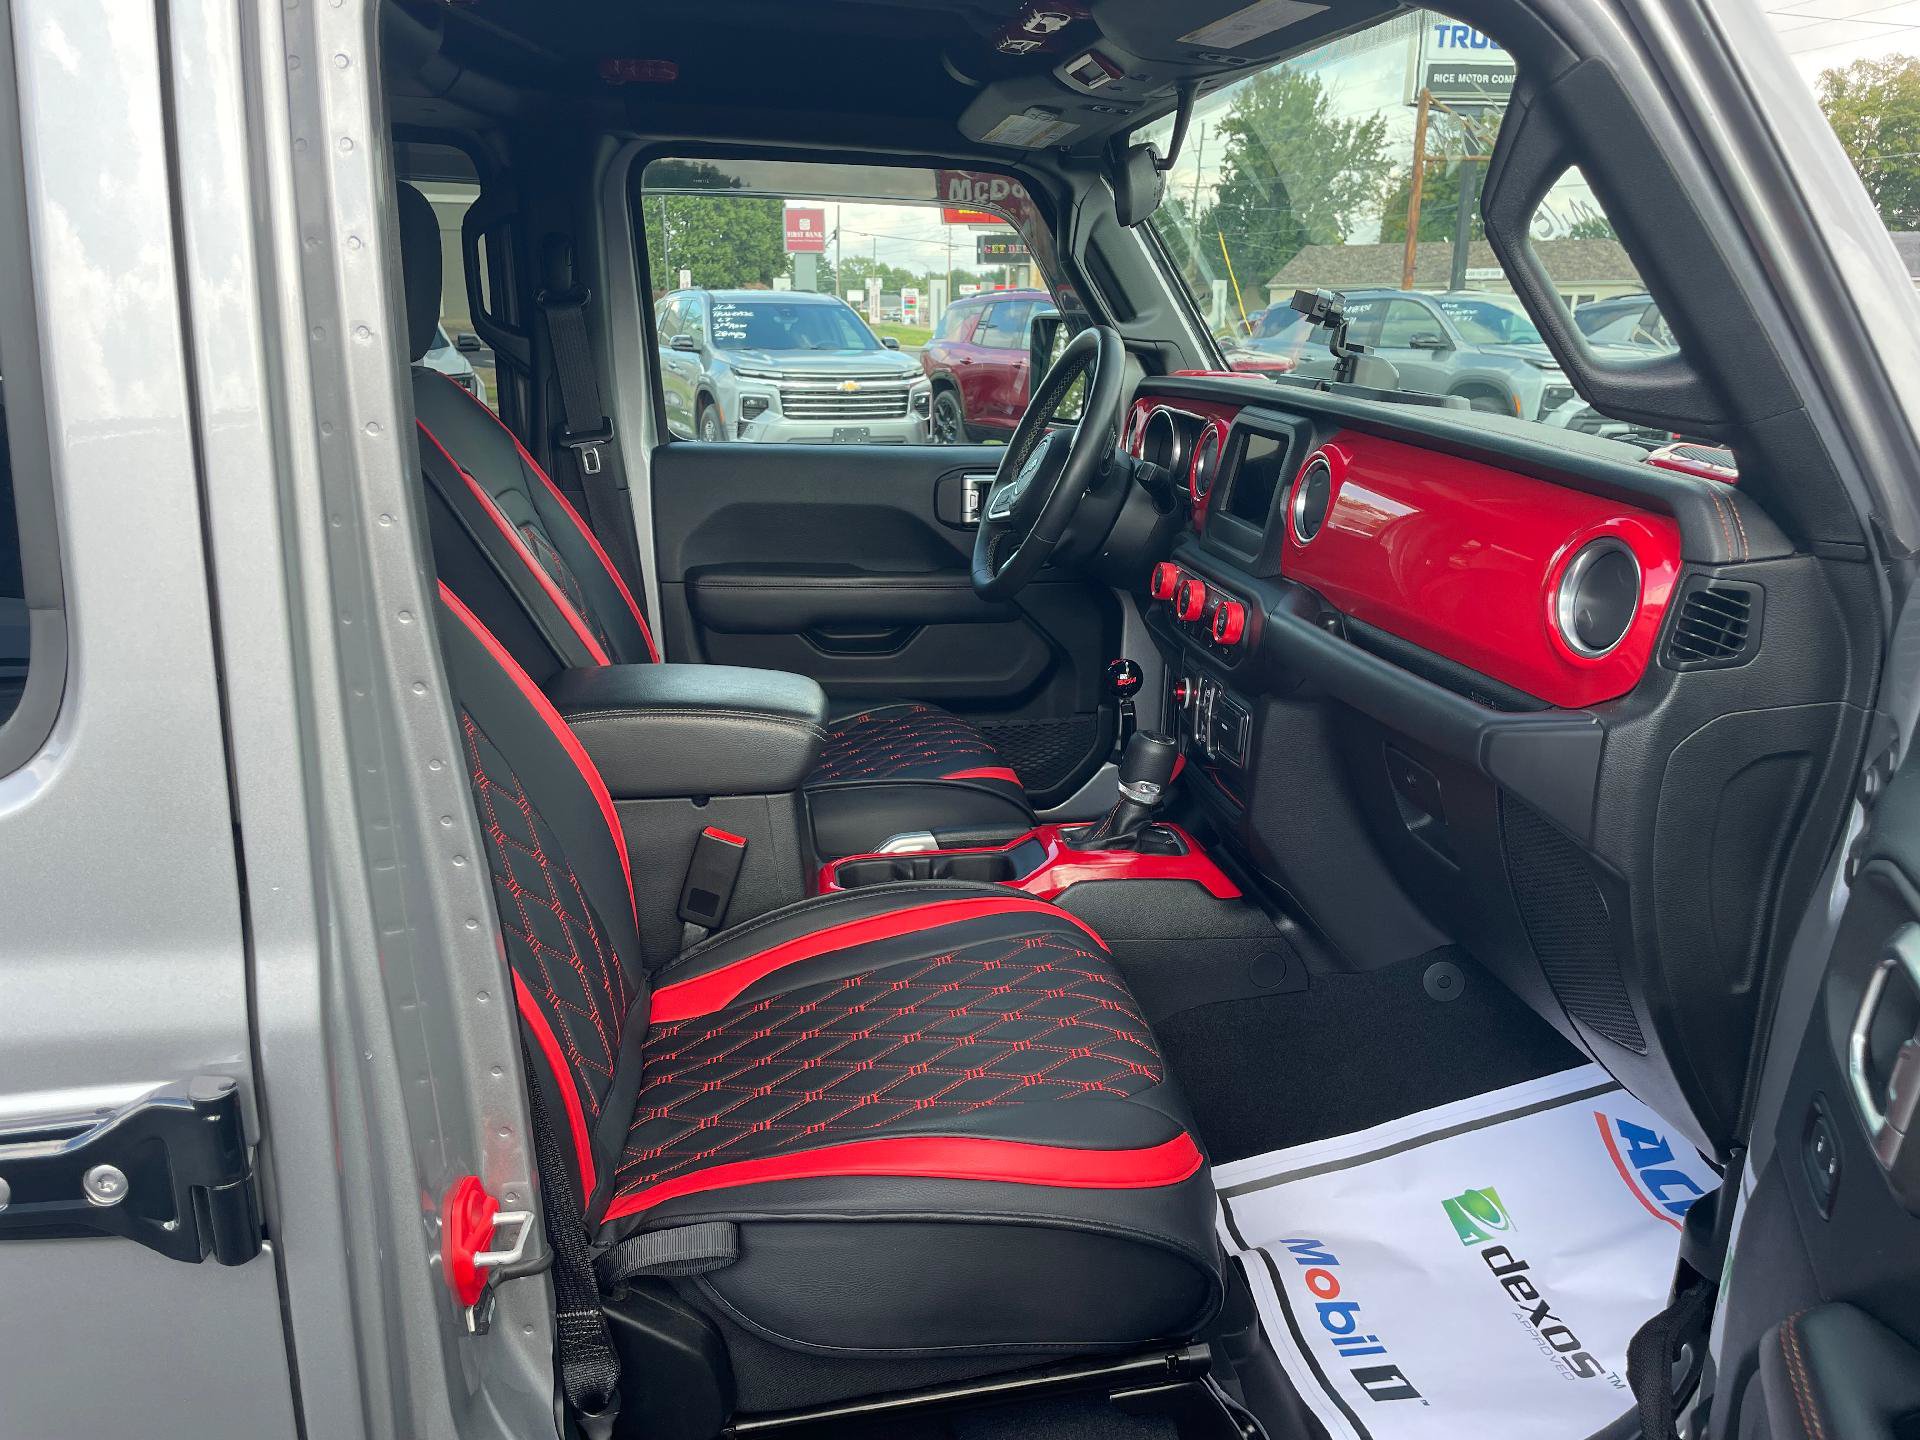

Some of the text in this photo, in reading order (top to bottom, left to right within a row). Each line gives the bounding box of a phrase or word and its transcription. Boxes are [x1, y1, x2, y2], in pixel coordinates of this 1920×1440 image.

[1433, 73, 1455, 83] RICE
[1458, 73, 1489, 83] MOTOR
[949, 179, 1029, 203] McDo
[1280, 1237, 1387, 1357] Mobil
[1481, 1245, 1607, 1379] dexos
[1512, 1311, 1576, 1381] APPROVED
